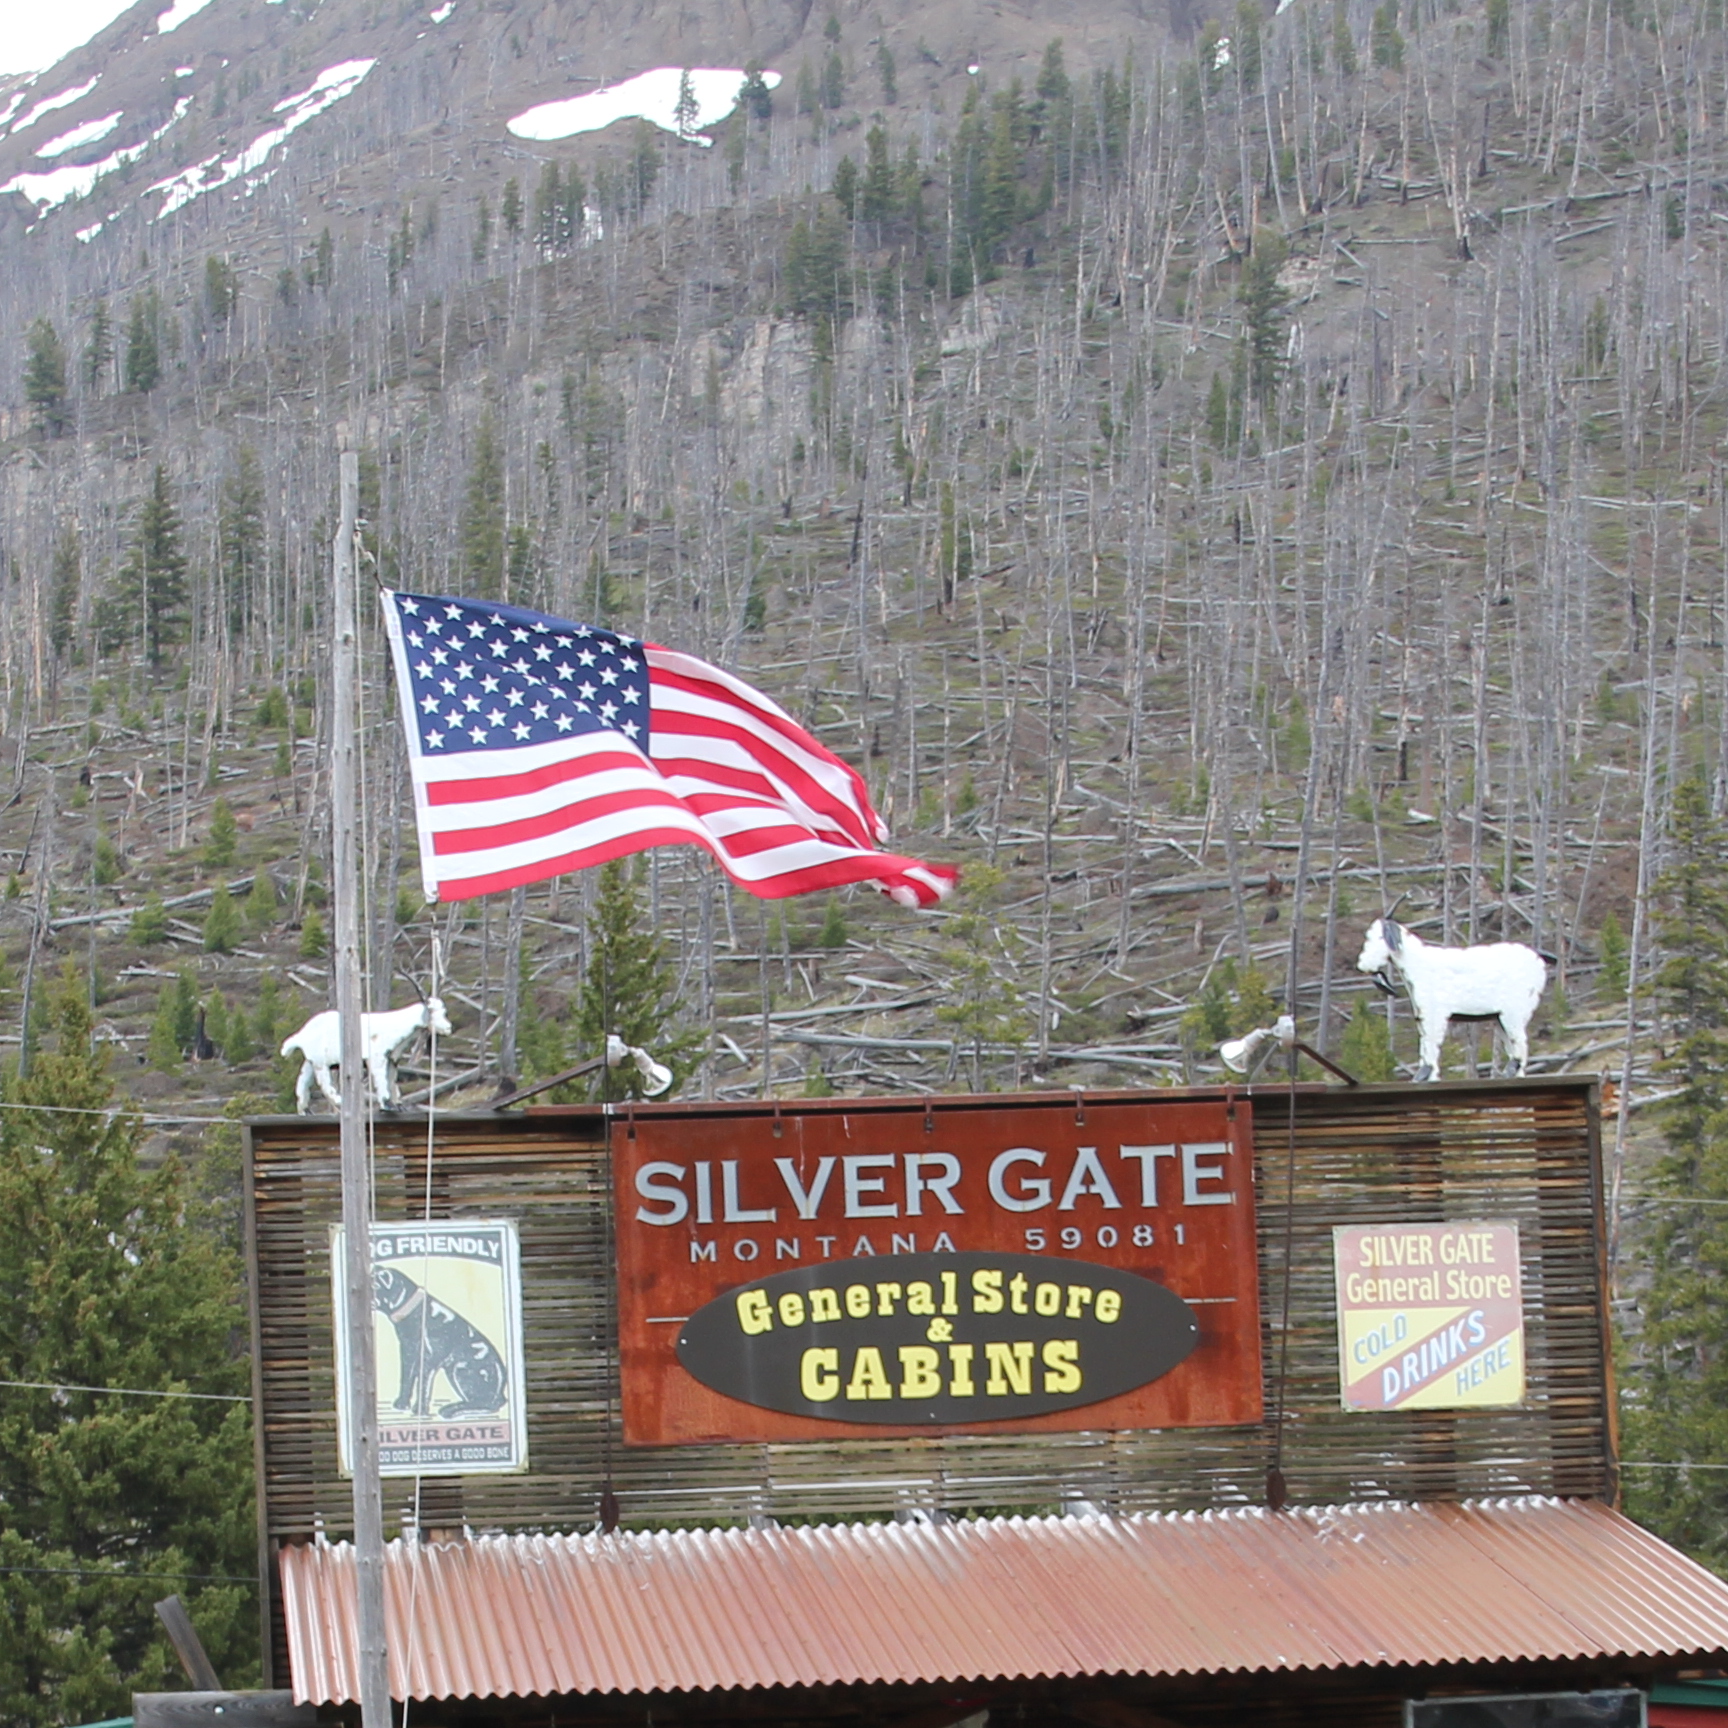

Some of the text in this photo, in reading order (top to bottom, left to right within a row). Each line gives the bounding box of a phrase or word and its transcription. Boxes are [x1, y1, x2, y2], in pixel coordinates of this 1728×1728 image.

[633, 1141, 1237, 1226] SILVER GATE
[396, 1236, 499, 1258] FRIENDLY
[689, 1223, 1186, 1264] MONTANA 59081
[1359, 1233, 1496, 1267] SILVER GATE
[735, 1269, 1123, 1336] General Store
[1346, 1269, 1512, 1303] General Store
[926, 1317, 953, 1343] &
[1353, 1312, 1408, 1365] COLD
[800, 1340, 1083, 1402] CABINS
[1382, 1309, 1486, 1405] DRINKS
[1456, 1337, 1511, 1396] HERE
[379, 1426, 504, 1444] ILVER GATE
[411, 1449, 452, 1461] DESERVES
[454, 1449, 461, 1458] A
[462, 1448, 484, 1459] GOOD
[487, 1447, 510, 1459] BONE
